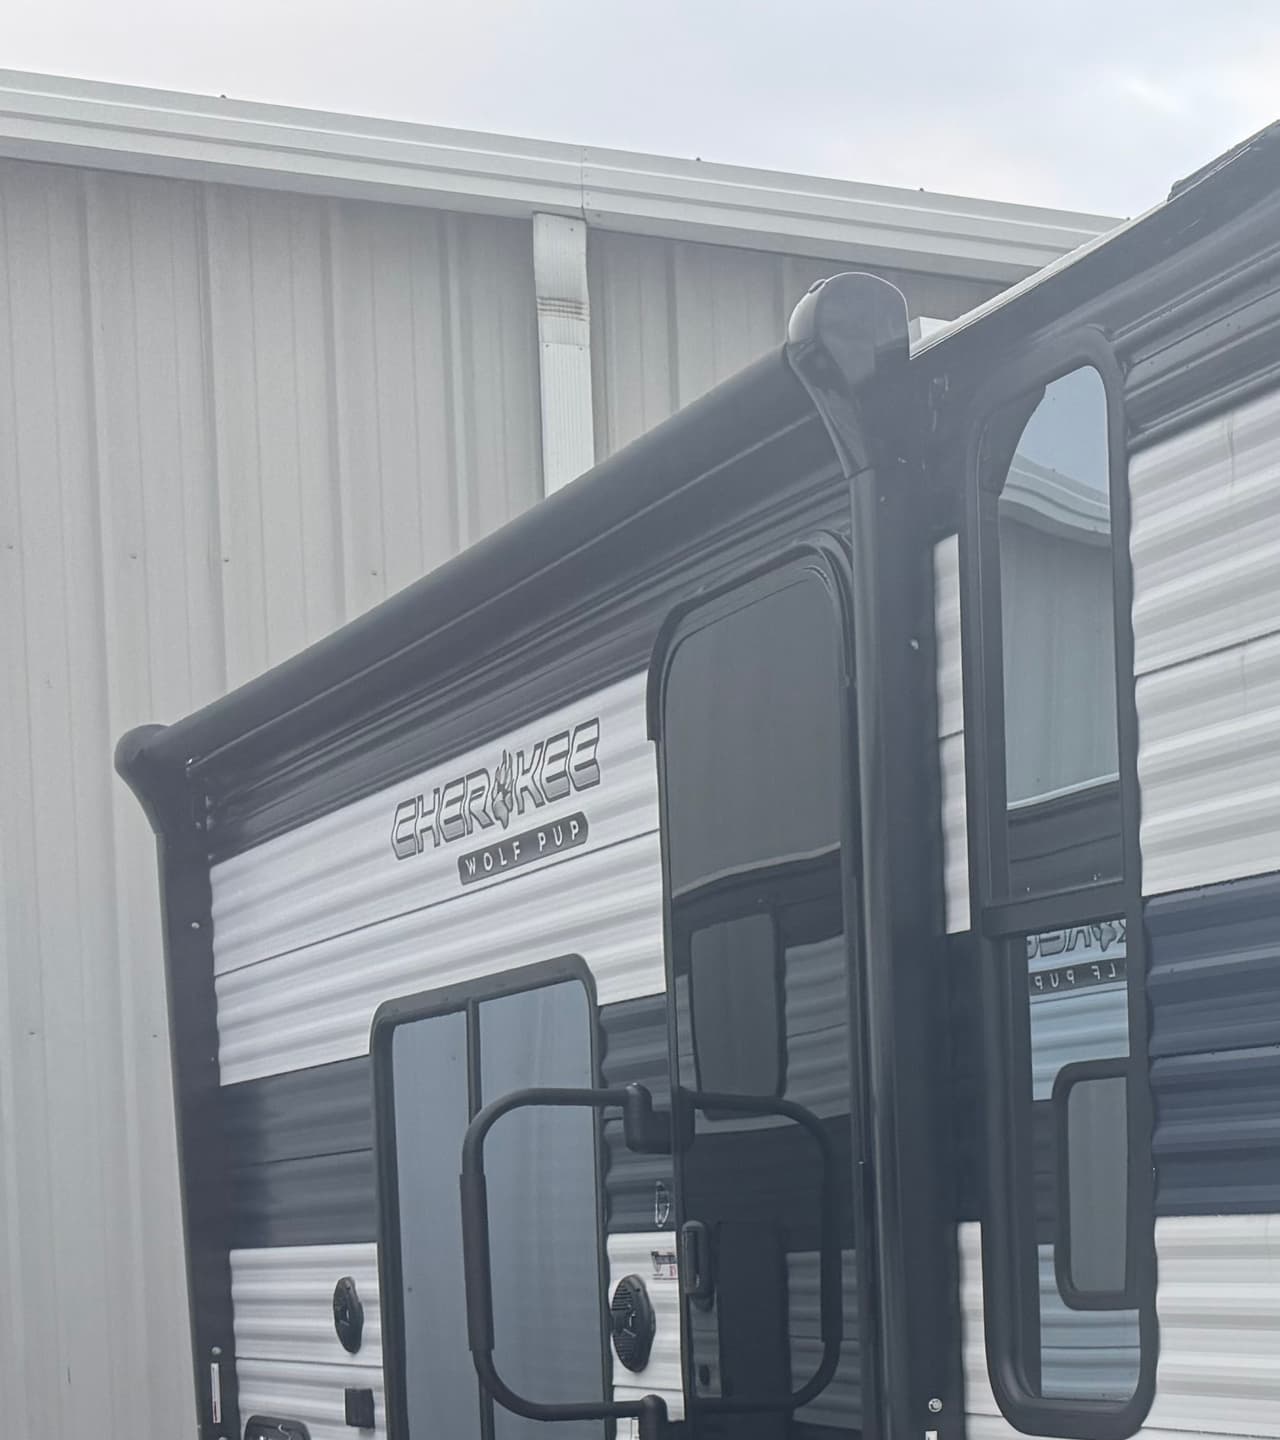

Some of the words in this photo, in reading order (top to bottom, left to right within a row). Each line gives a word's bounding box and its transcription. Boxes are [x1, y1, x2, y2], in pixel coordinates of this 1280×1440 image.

[391, 717, 600, 860] CHEROKEE
[465, 841, 521, 876] WOLF
[538, 820, 580, 852] PUP
